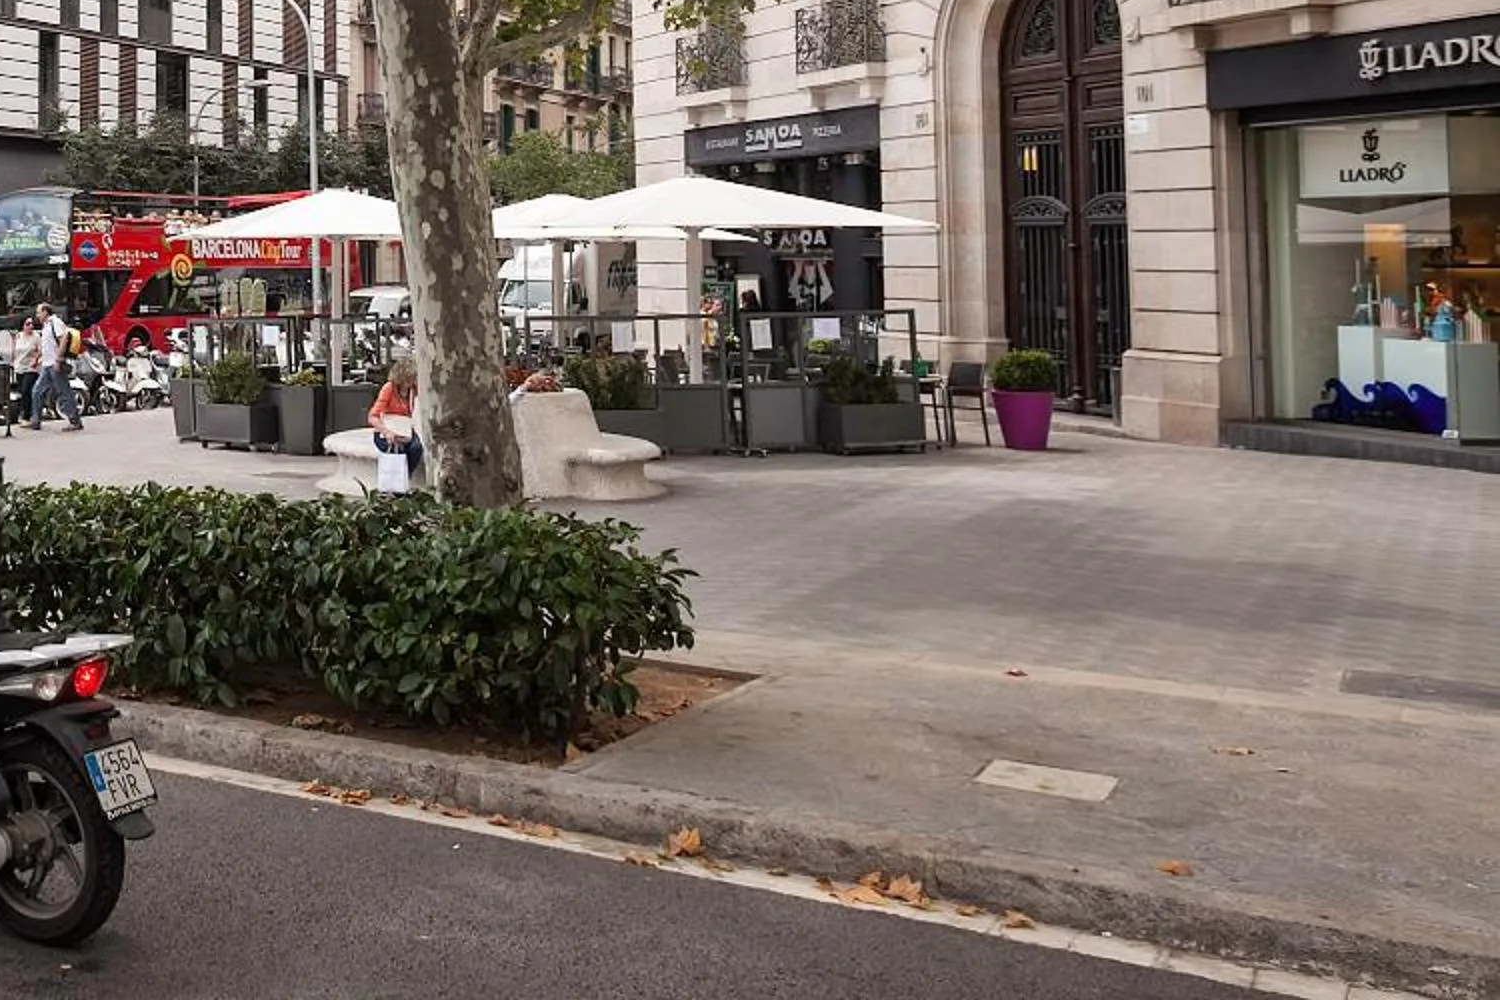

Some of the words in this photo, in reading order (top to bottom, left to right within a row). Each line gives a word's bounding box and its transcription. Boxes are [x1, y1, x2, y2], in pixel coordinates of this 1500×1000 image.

[1386, 34, 1500, 73] LLADR
[745, 123, 802, 149] SAMOA
[1338, 161, 1404, 183] LLADRÓ
[191, 238, 261, 259] BARCELONA
[101, 745, 140, 775] 4564
[107, 773, 142, 803] FVR
